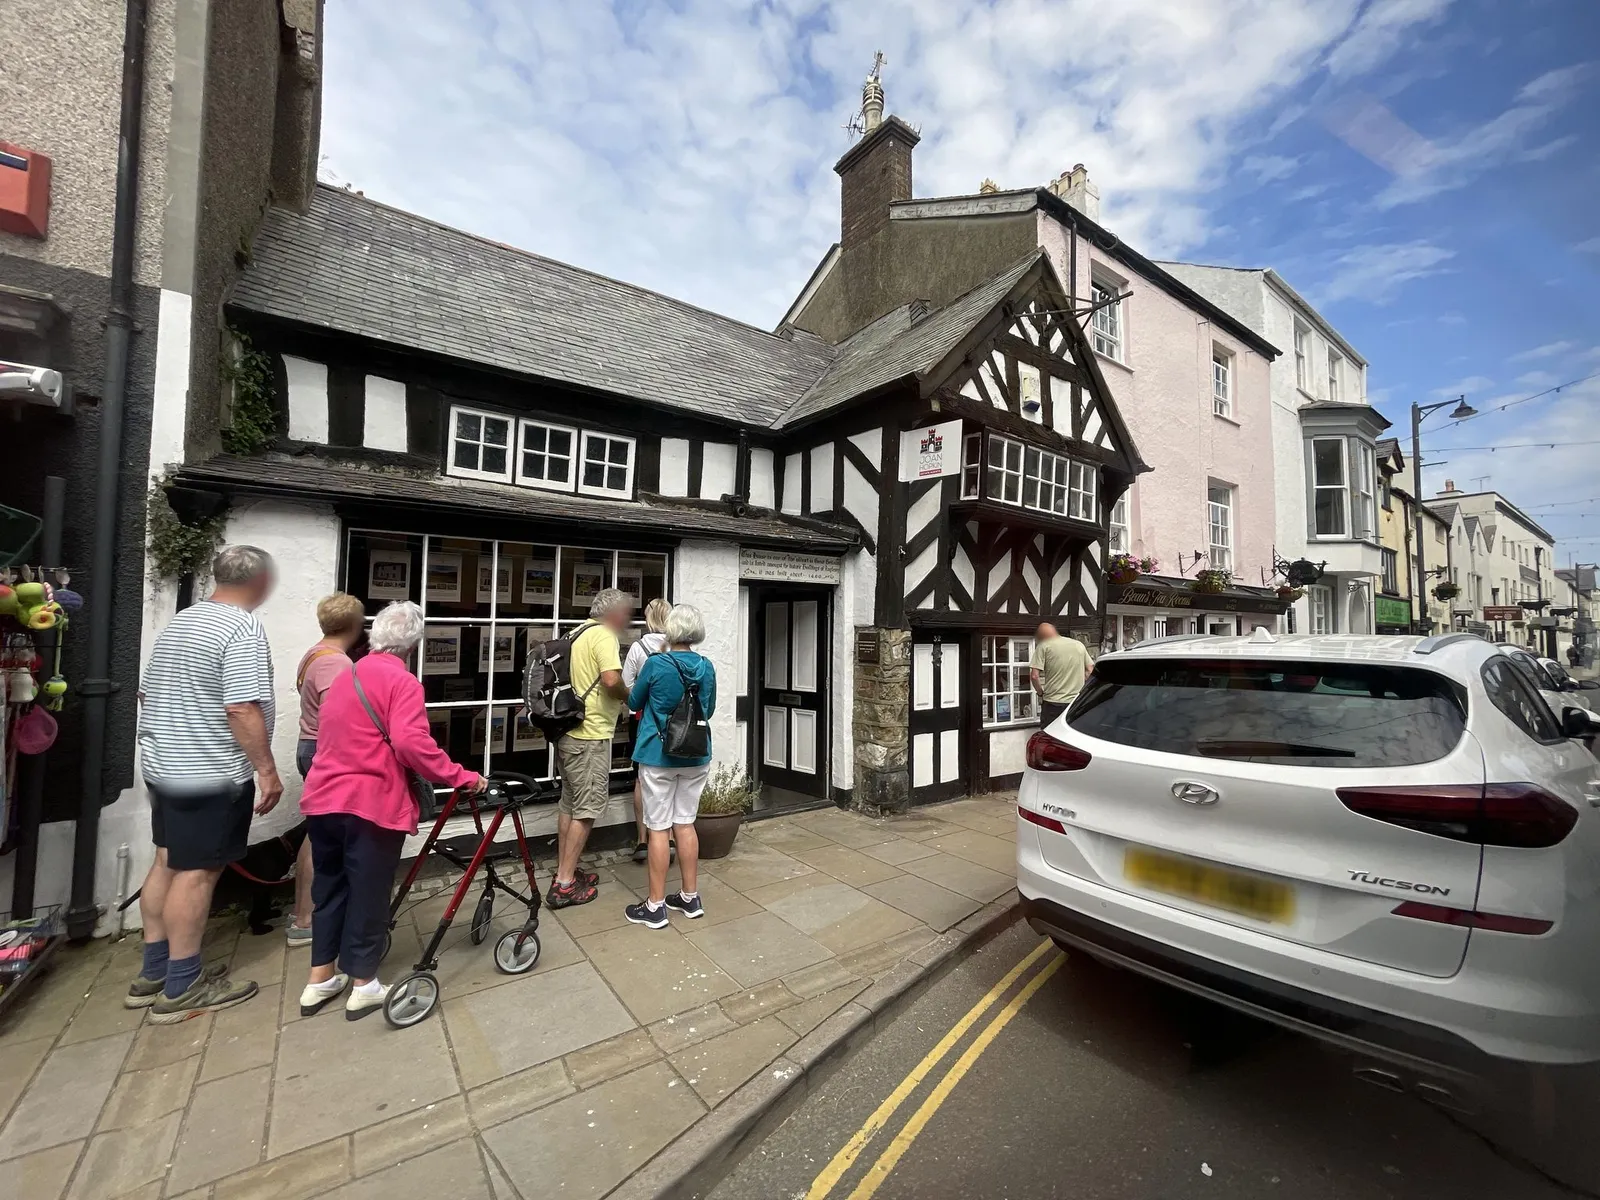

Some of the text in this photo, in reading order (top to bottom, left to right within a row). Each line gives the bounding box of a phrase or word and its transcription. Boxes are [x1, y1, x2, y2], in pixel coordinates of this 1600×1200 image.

[919, 453, 943, 465] JOAN
[919, 462, 943, 470] HOPKIN
[1118, 586, 1151, 604] Beau's
[1149, 589, 1167, 606] Tea
[1347, 869, 1451, 896] TUCSON
